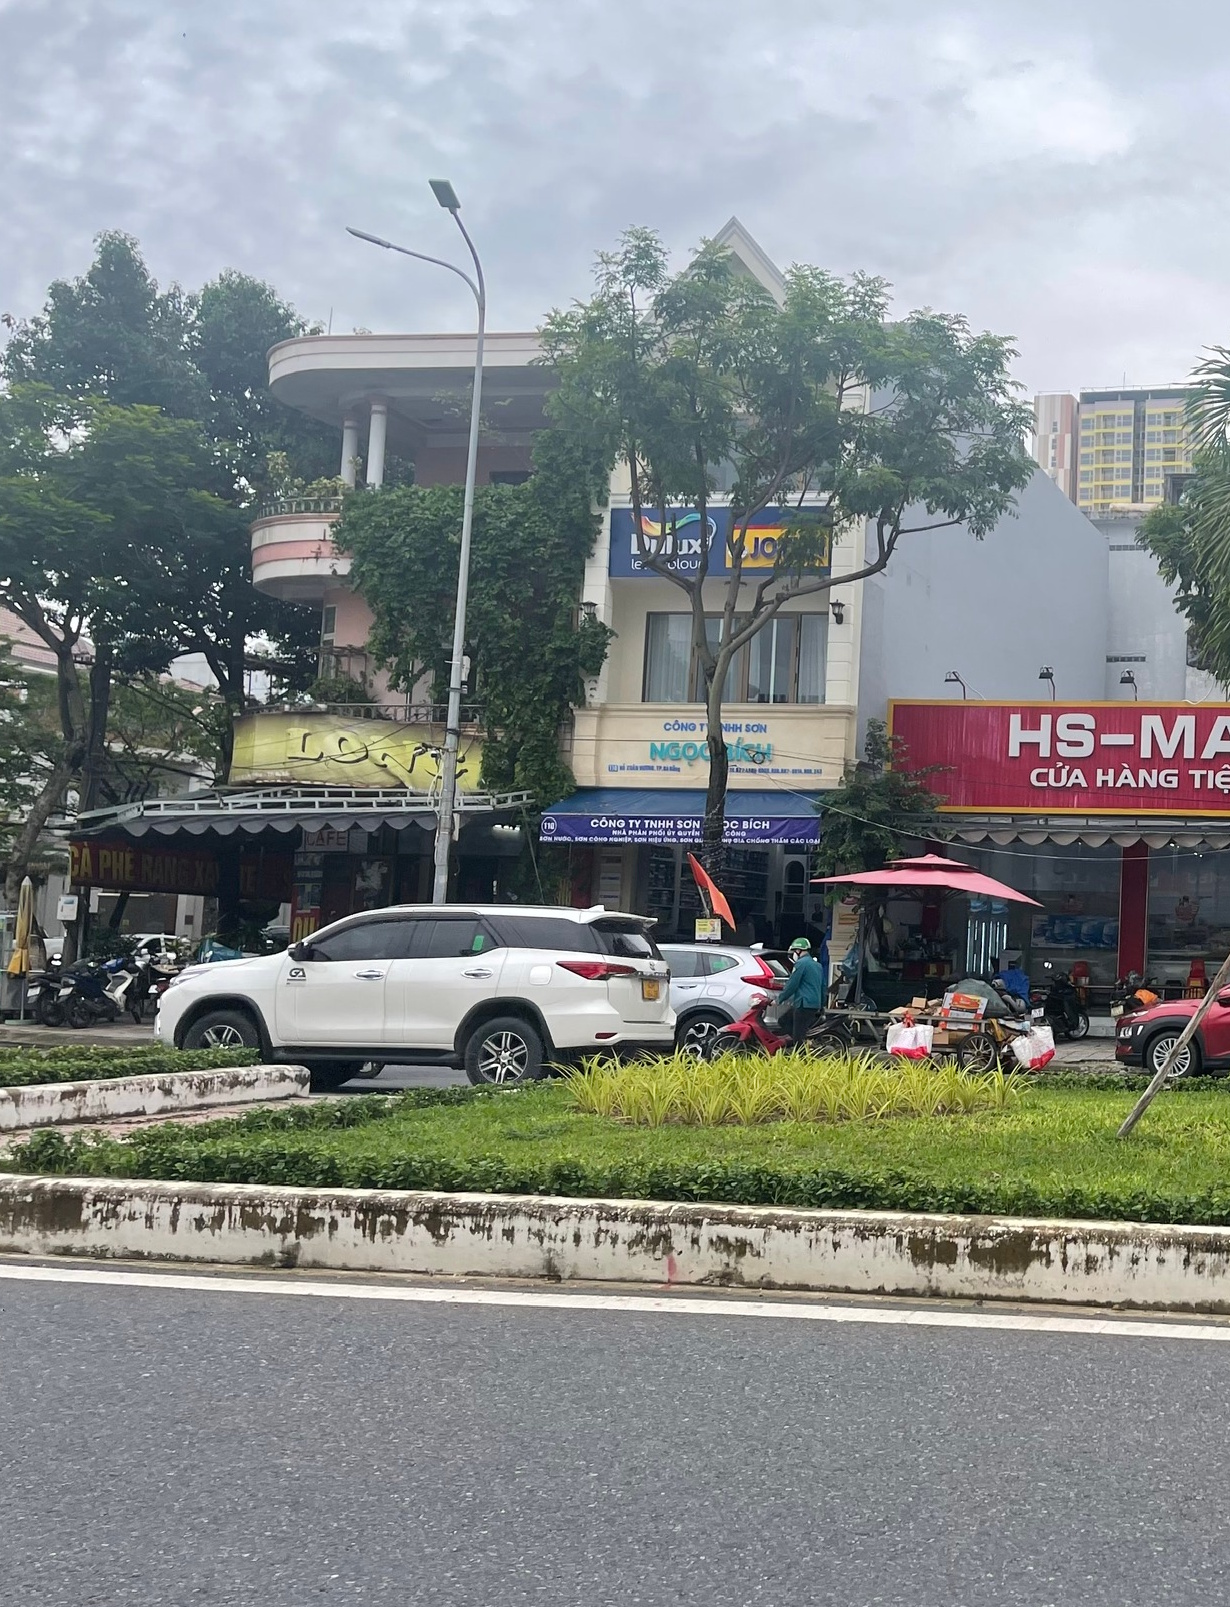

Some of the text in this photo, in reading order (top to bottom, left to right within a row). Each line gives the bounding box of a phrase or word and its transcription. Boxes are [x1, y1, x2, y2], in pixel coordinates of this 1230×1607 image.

[663, 720, 697, 732] CÔNG
[745, 723, 767, 733] SƠN
[650, 742, 711, 766] NGỌC
[1030, 762, 1088, 787] CỬA
[1096, 763, 1179, 789] HÀNG
[591, 817, 625, 828] CÔNG
[629, 820, 641, 828] TY
[644, 820, 673, 828] TNHH
[676, 820, 700, 829] SƠN
[742, 818, 770, 829] BÍCH
[306, 830, 346, 846] CAFE
[69, 842, 93, 878] CÀ
[100, 847, 134, 882] PHÊ
